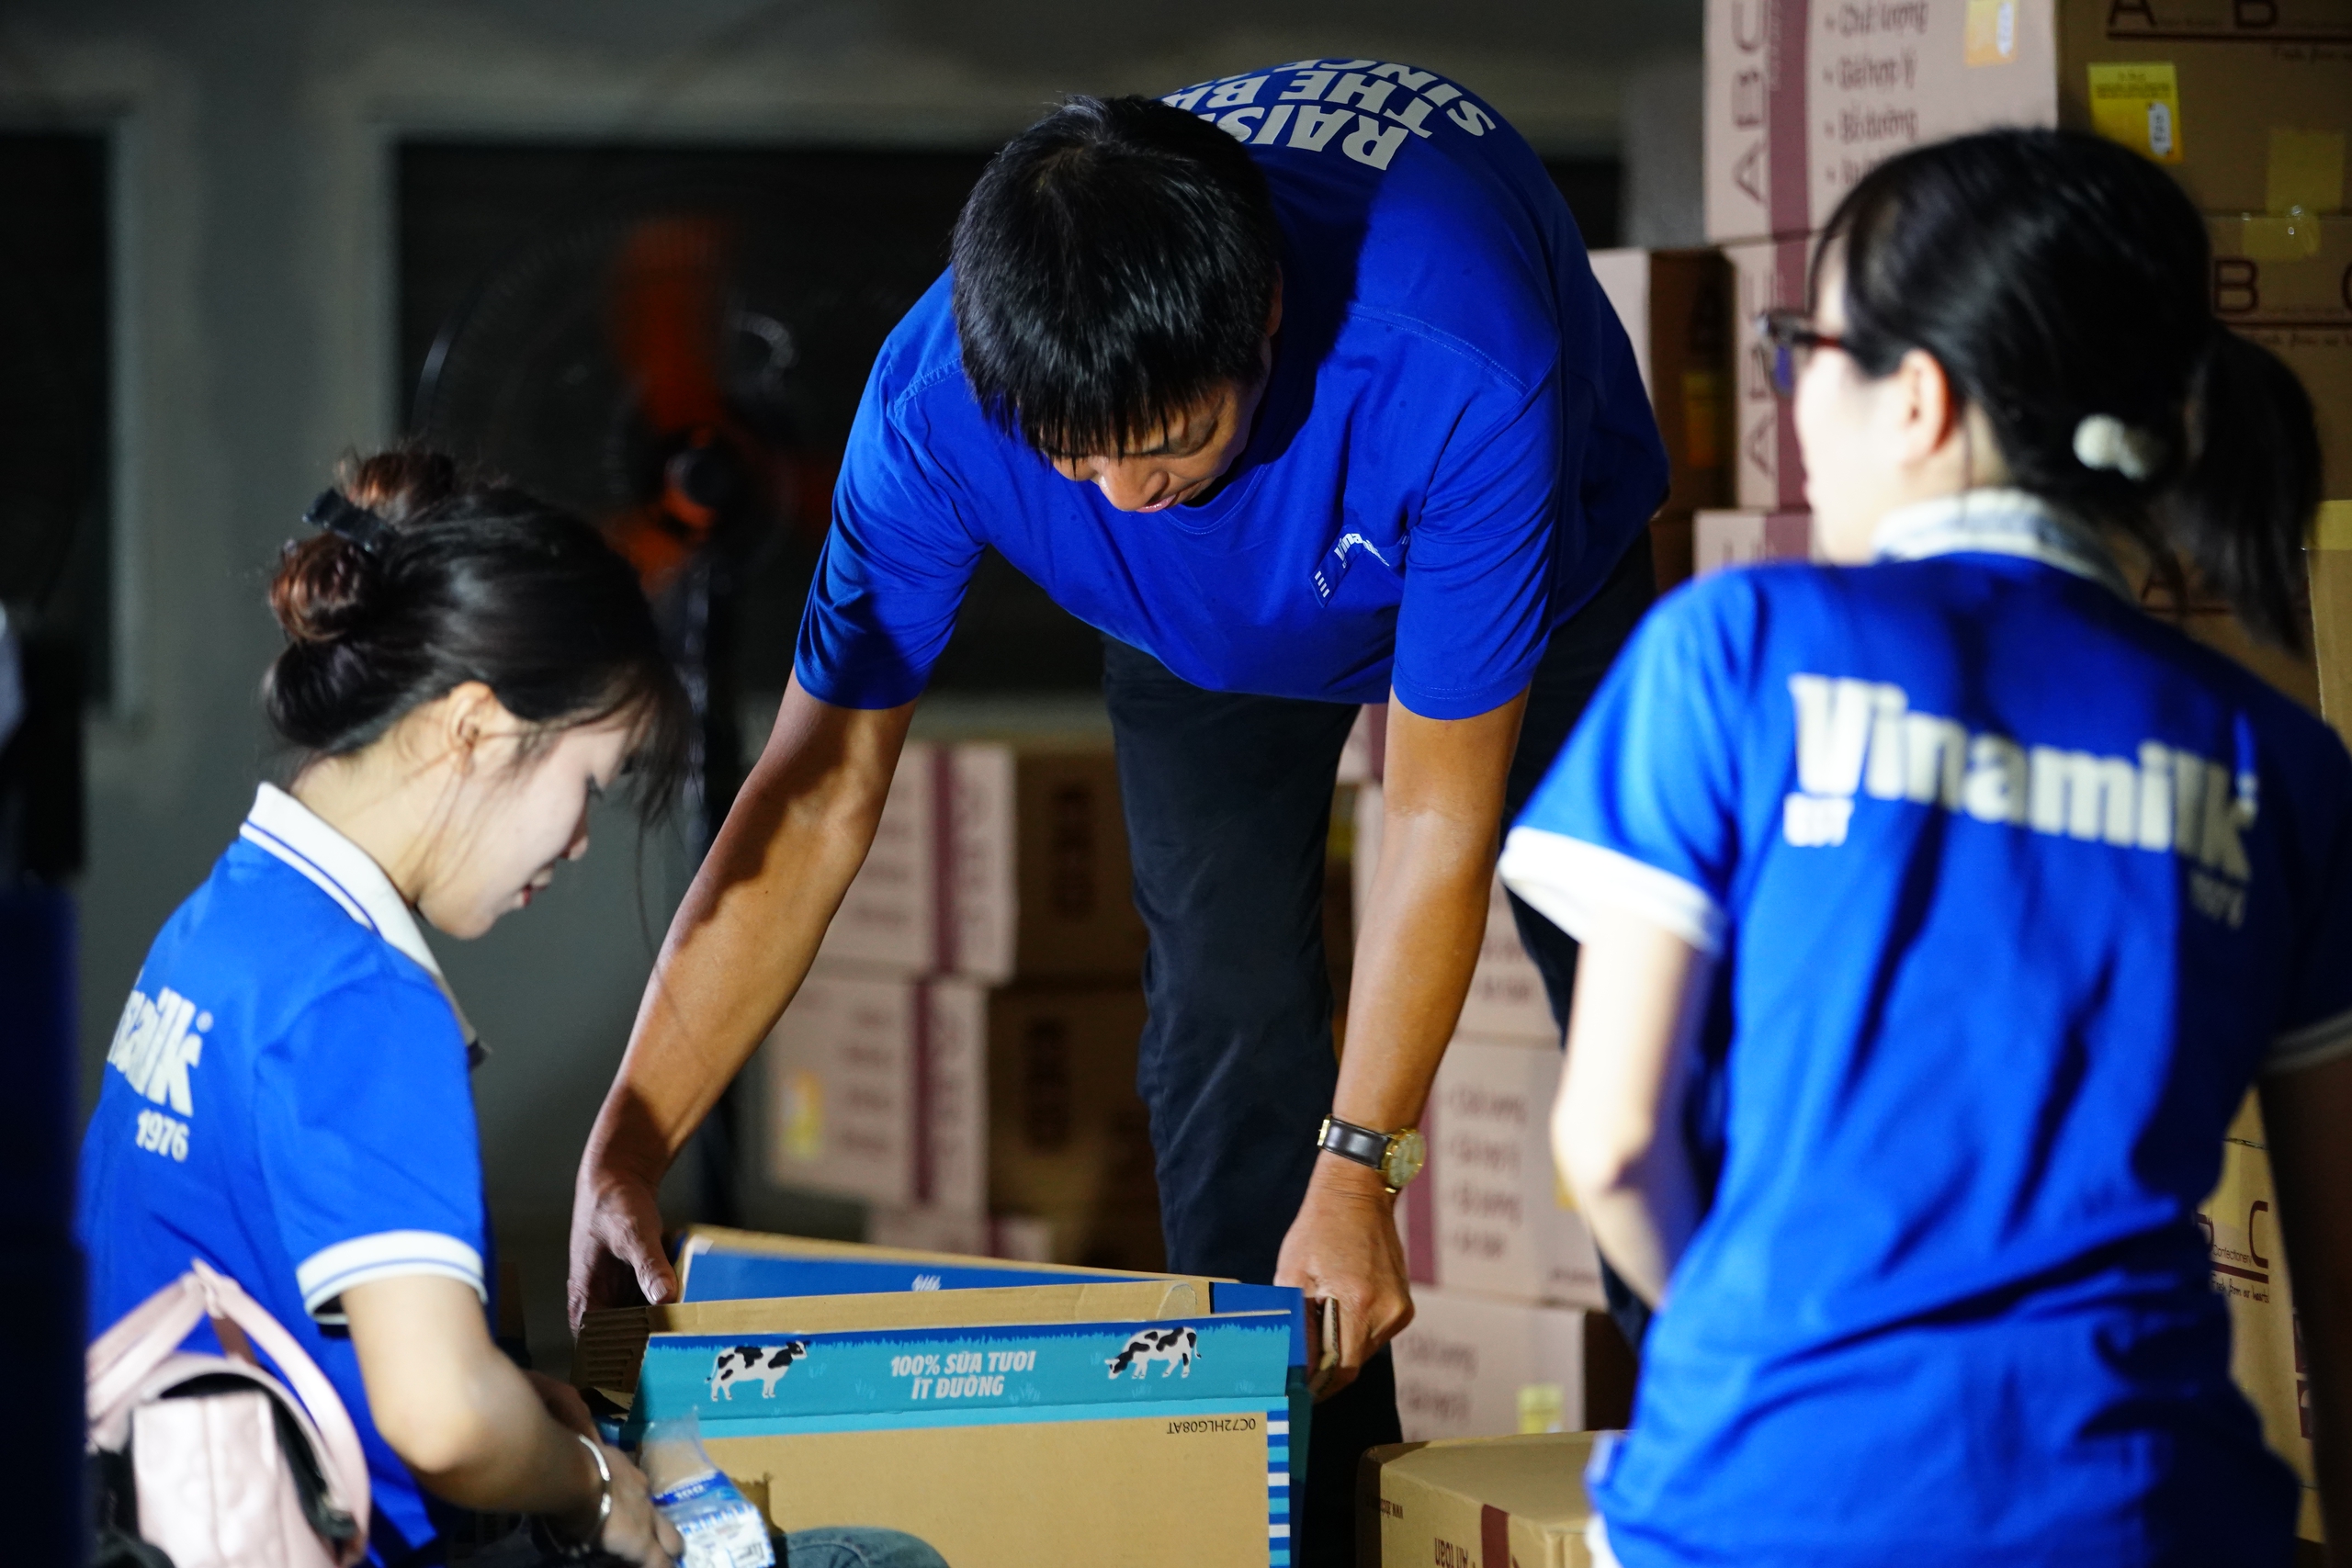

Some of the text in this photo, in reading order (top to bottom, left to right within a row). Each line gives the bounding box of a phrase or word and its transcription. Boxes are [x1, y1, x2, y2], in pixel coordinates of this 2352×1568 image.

[1161, 74, 1271, 111] BA
[1278, 70, 1433, 139] THE
[1196, 105, 1409, 171] RAIS
[1788, 672, 2258, 882] Vinamilk
[135, 1108, 190, 1163] 1976
[890, 1353, 941, 1377] 100%
[1167, 1418, 1257, 1435] 0C72HLG08AT
